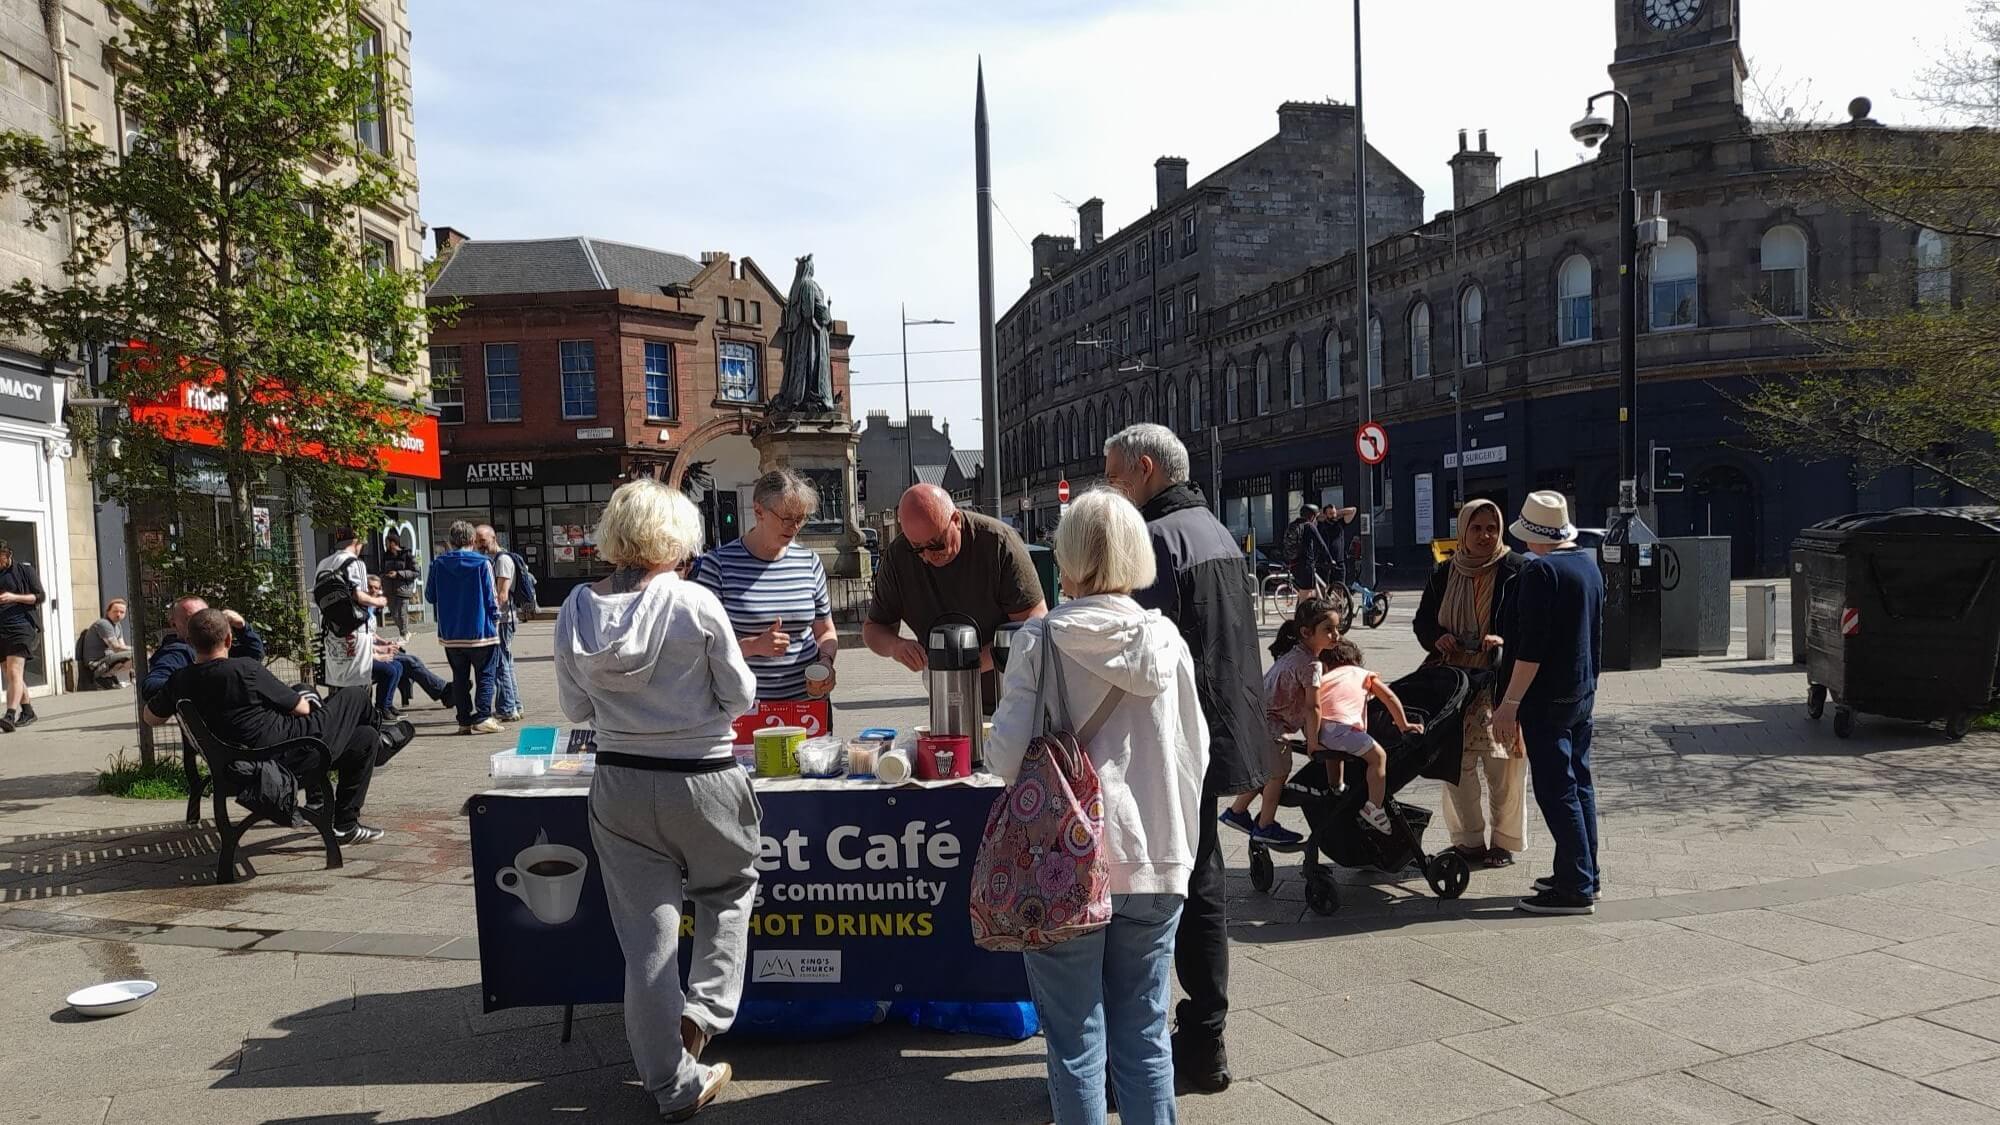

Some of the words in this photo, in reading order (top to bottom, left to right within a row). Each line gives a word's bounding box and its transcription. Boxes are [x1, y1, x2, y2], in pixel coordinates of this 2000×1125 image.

[1465, 449, 1497, 463] SURGERY
[466, 461, 534, 478] AFREEN
[826, 819, 961, 870] Café
[772, 875, 947, 906] community
[815, 912, 933, 936] DRINKS
